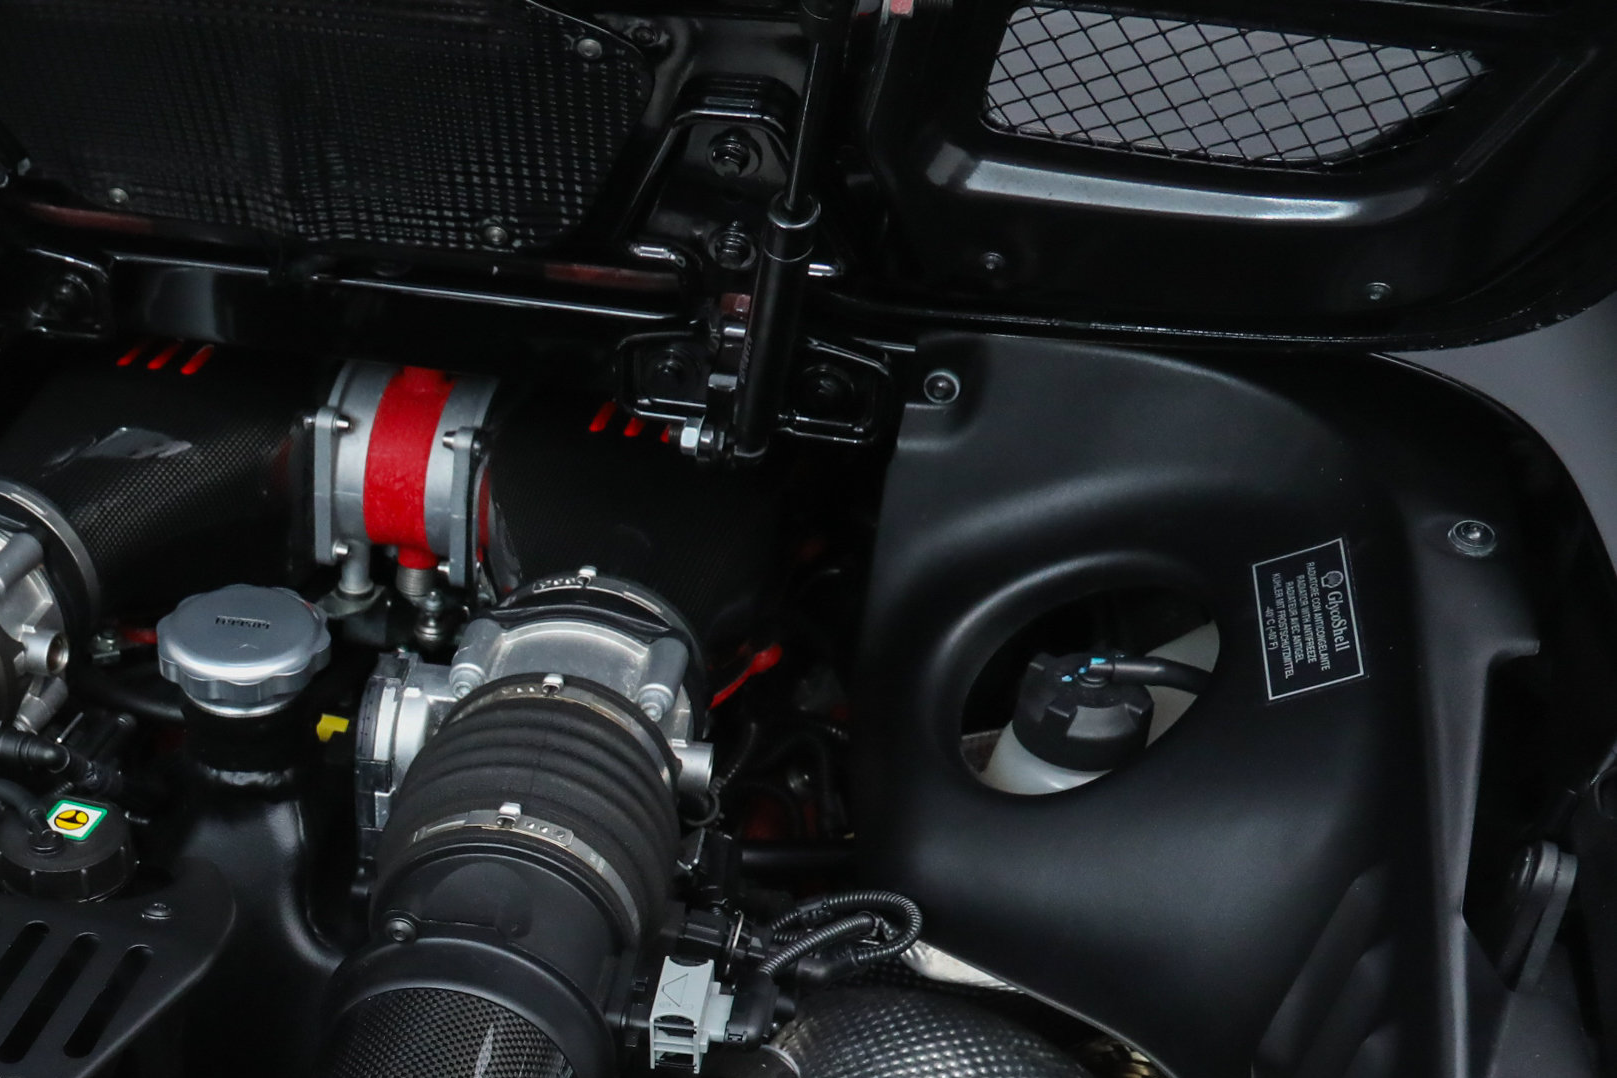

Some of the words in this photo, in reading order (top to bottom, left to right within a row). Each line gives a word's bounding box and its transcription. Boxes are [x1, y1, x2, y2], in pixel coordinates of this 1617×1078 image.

[1296, 575, 1308, 605] RADIATOR
[1306, 561, 1319, 597] RADIATORE
[1275, 598, 1284, 610] MIT
[1285, 581, 1298, 616] RADIATEUR
[1300, 606, 1310, 623] WITH
[1311, 597, 1321, 612] CON
[1290, 617, 1300, 634] AVEC
[1325, 591, 1350, 652] GlycoShell
[1277, 609, 1294, 679] FROSTSCHUTZMITTEL
[1293, 634, 1304, 663] ANTIGEL
[1303, 623, 1317, 663] ANTIFREEZE
[1313, 612, 1330, 671] ANTICONGELANTE
